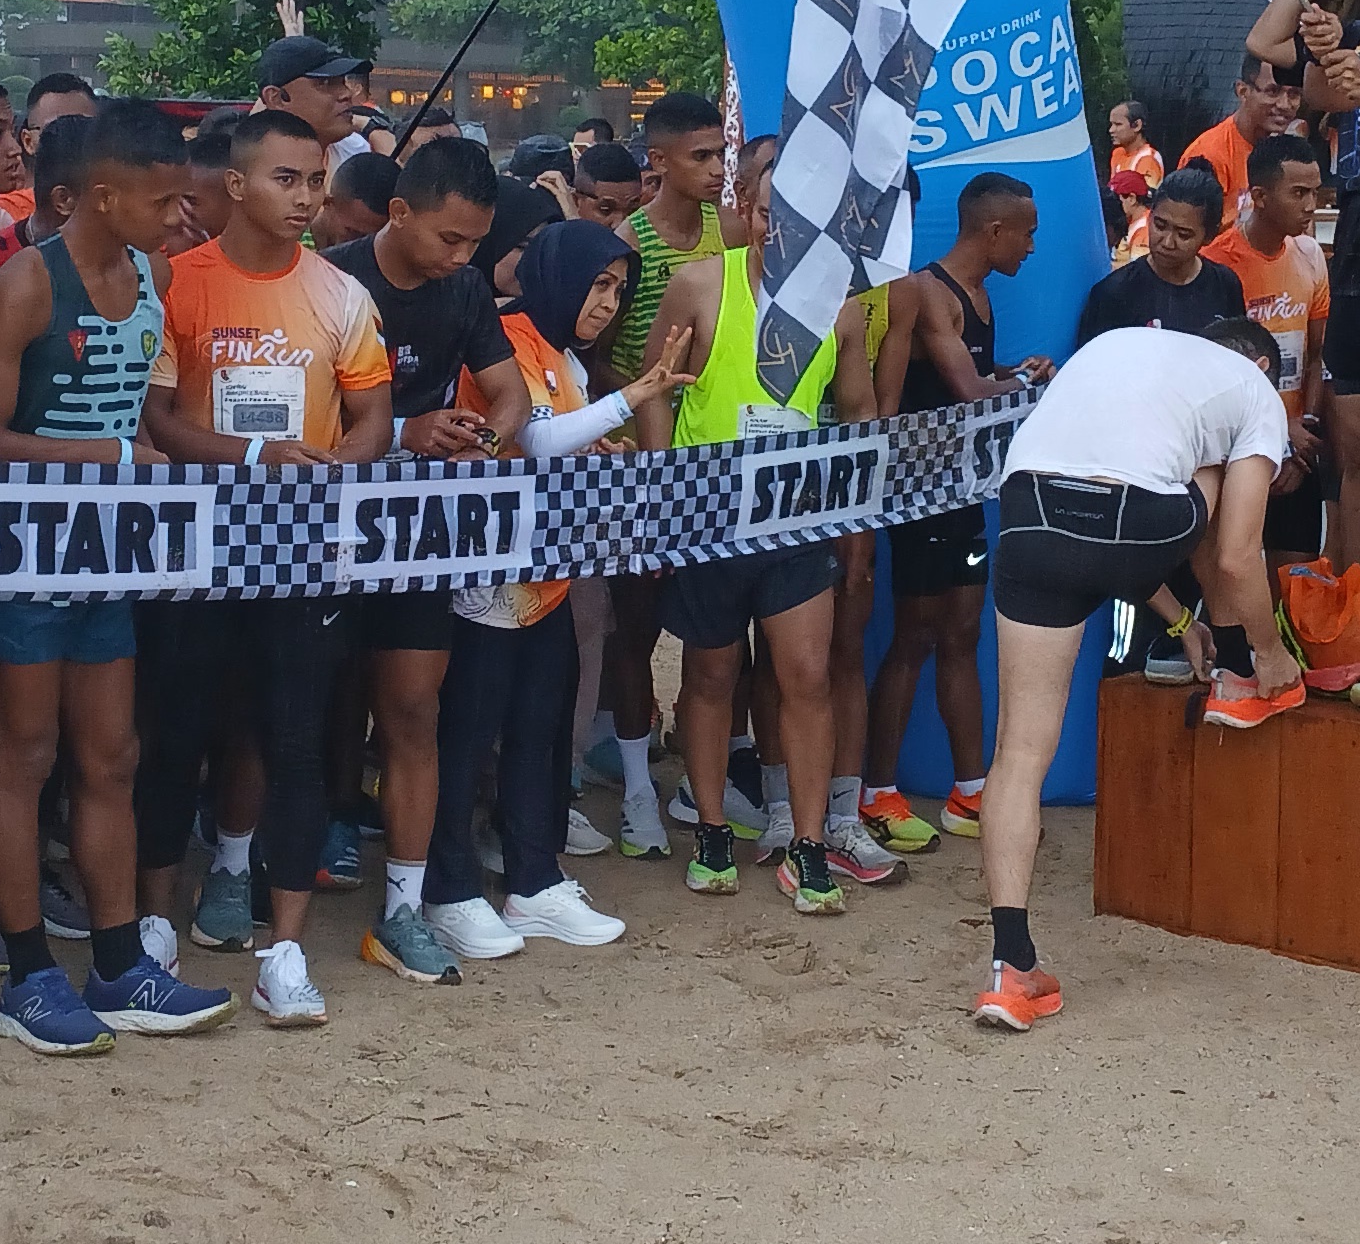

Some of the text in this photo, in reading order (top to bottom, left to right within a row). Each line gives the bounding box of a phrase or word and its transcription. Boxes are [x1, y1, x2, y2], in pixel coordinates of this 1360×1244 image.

[923, 15, 1078, 96] OCA
[1001, 8, 1042, 35] DRINK
[908, 56, 1081, 153] SWEA
[212, 327, 261, 339] SUNSET
[750, 448, 880, 525] START
[355, 490, 521, 568] START
